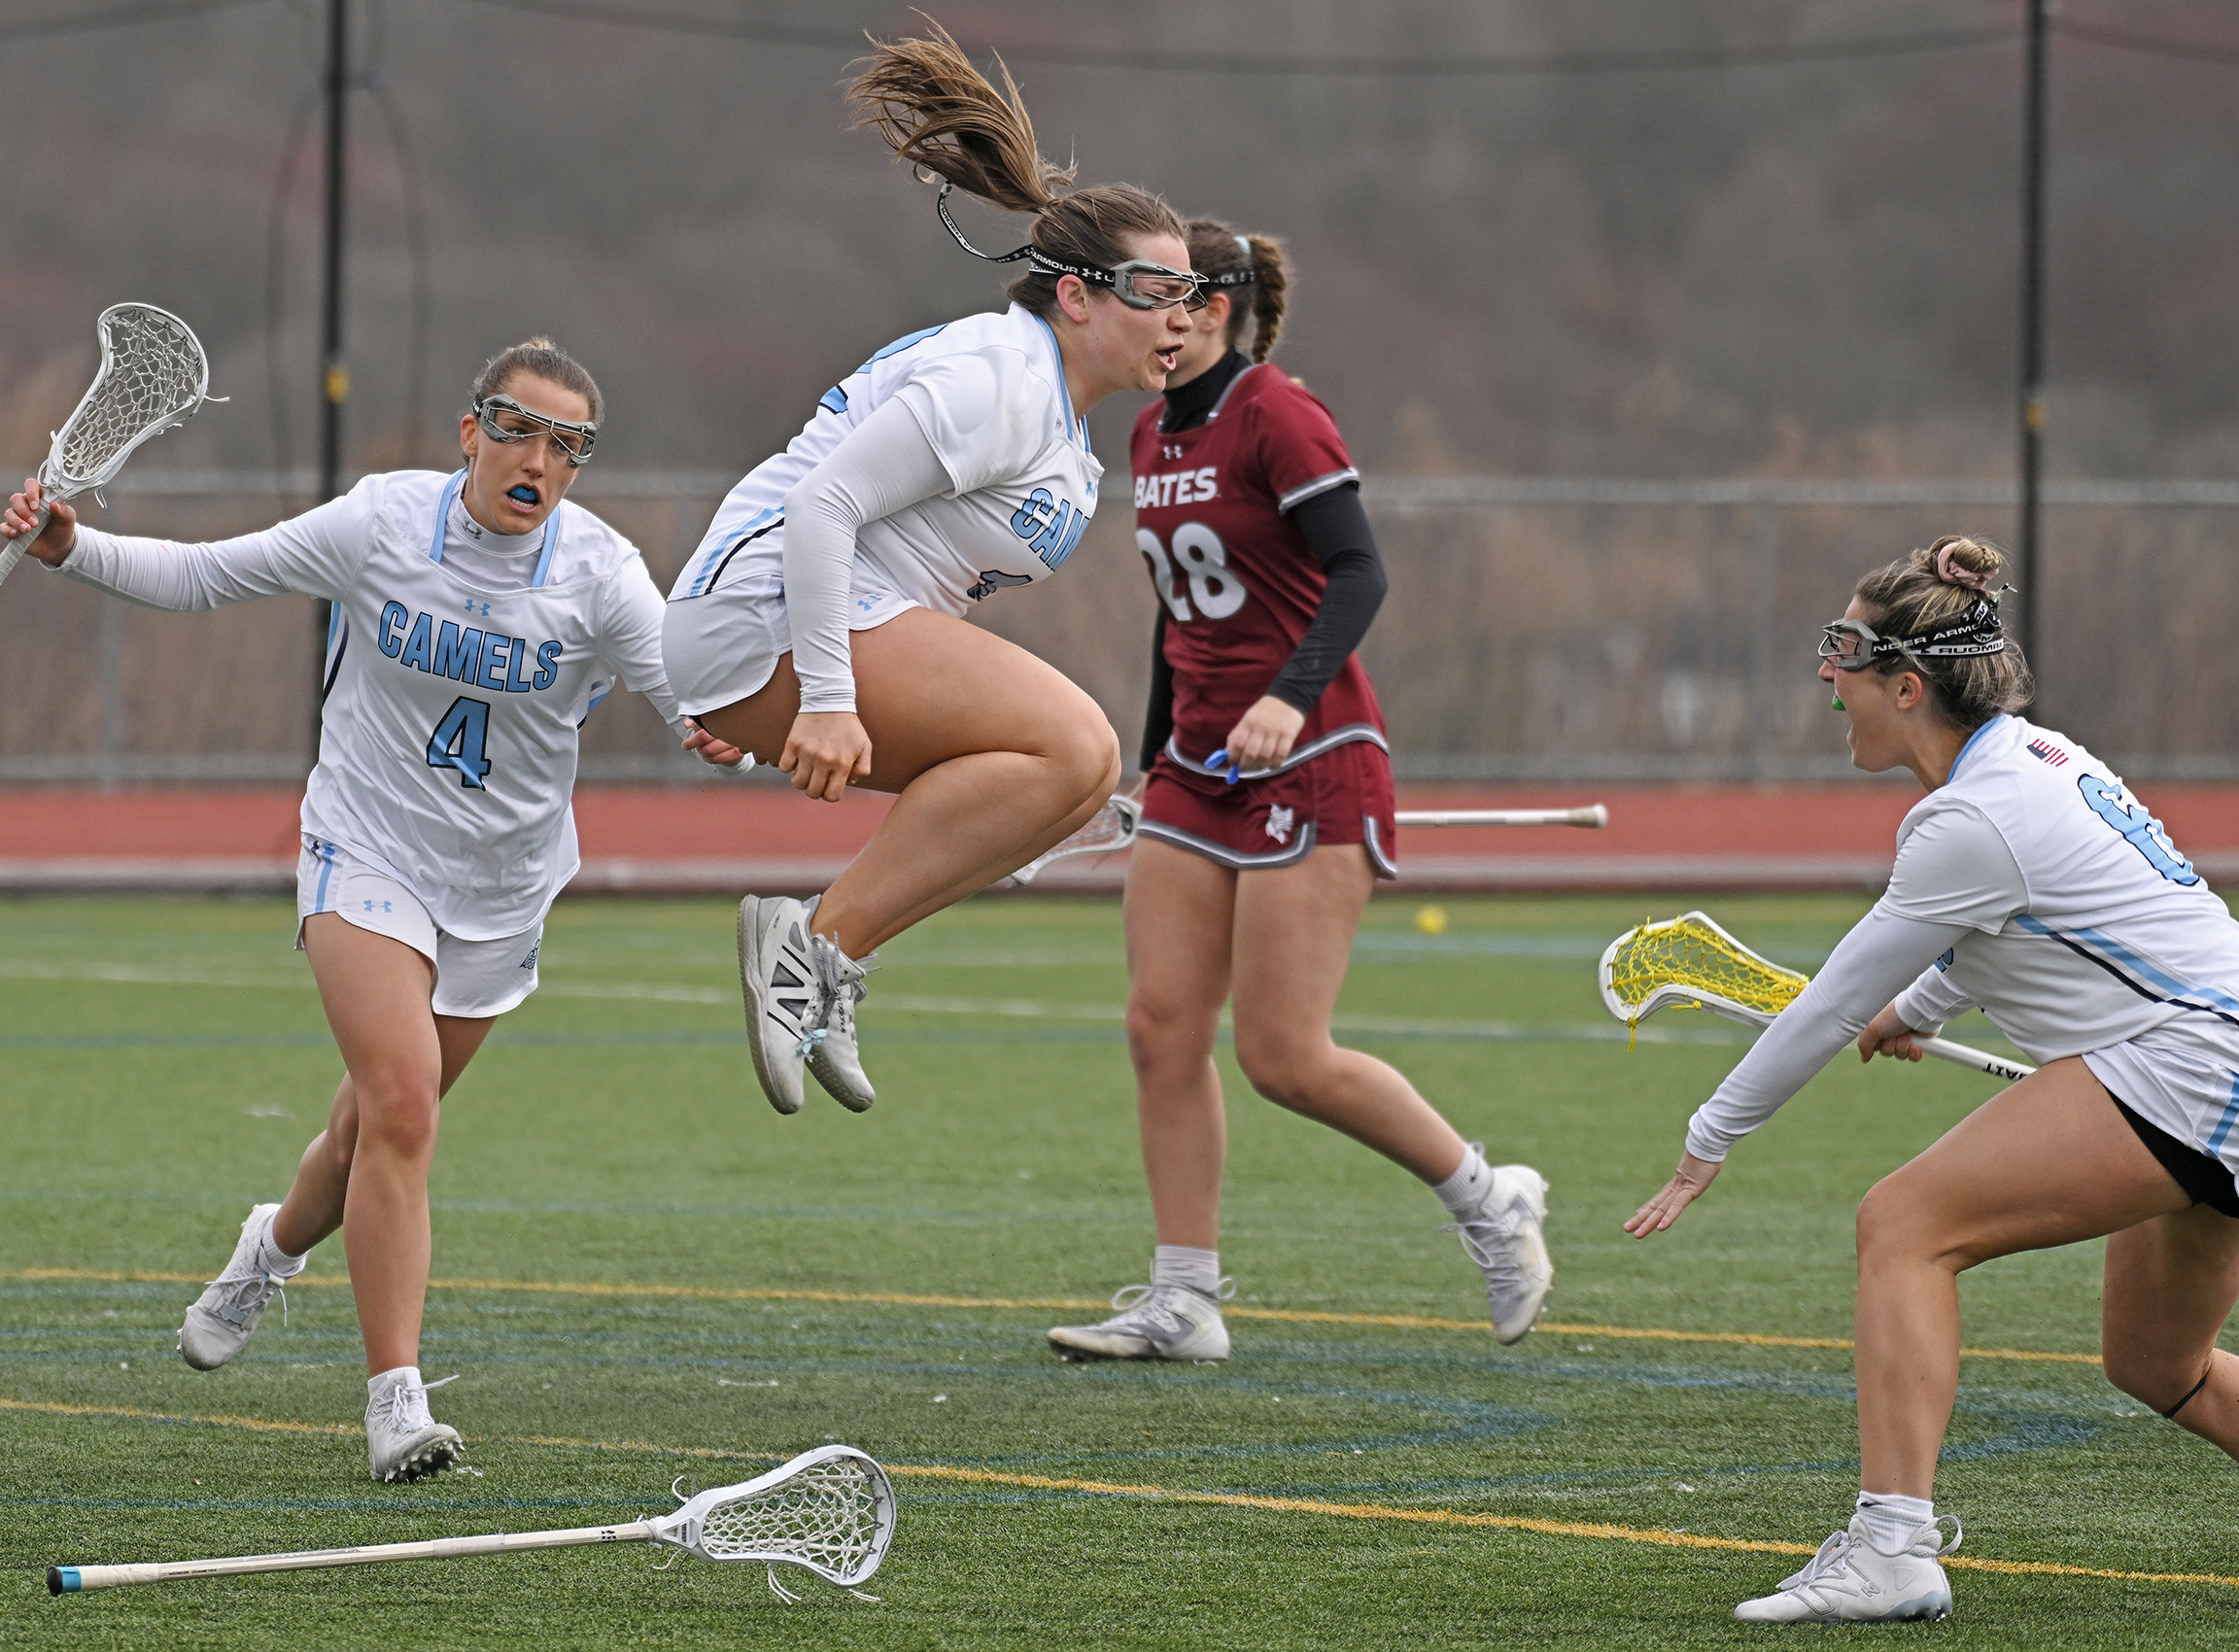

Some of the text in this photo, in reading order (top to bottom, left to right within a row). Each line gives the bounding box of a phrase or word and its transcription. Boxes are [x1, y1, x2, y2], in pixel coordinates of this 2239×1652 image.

[1134, 466, 1218, 508] BATES
[377, 600, 563, 693] CAMELS
[426, 696, 492, 792] 4
